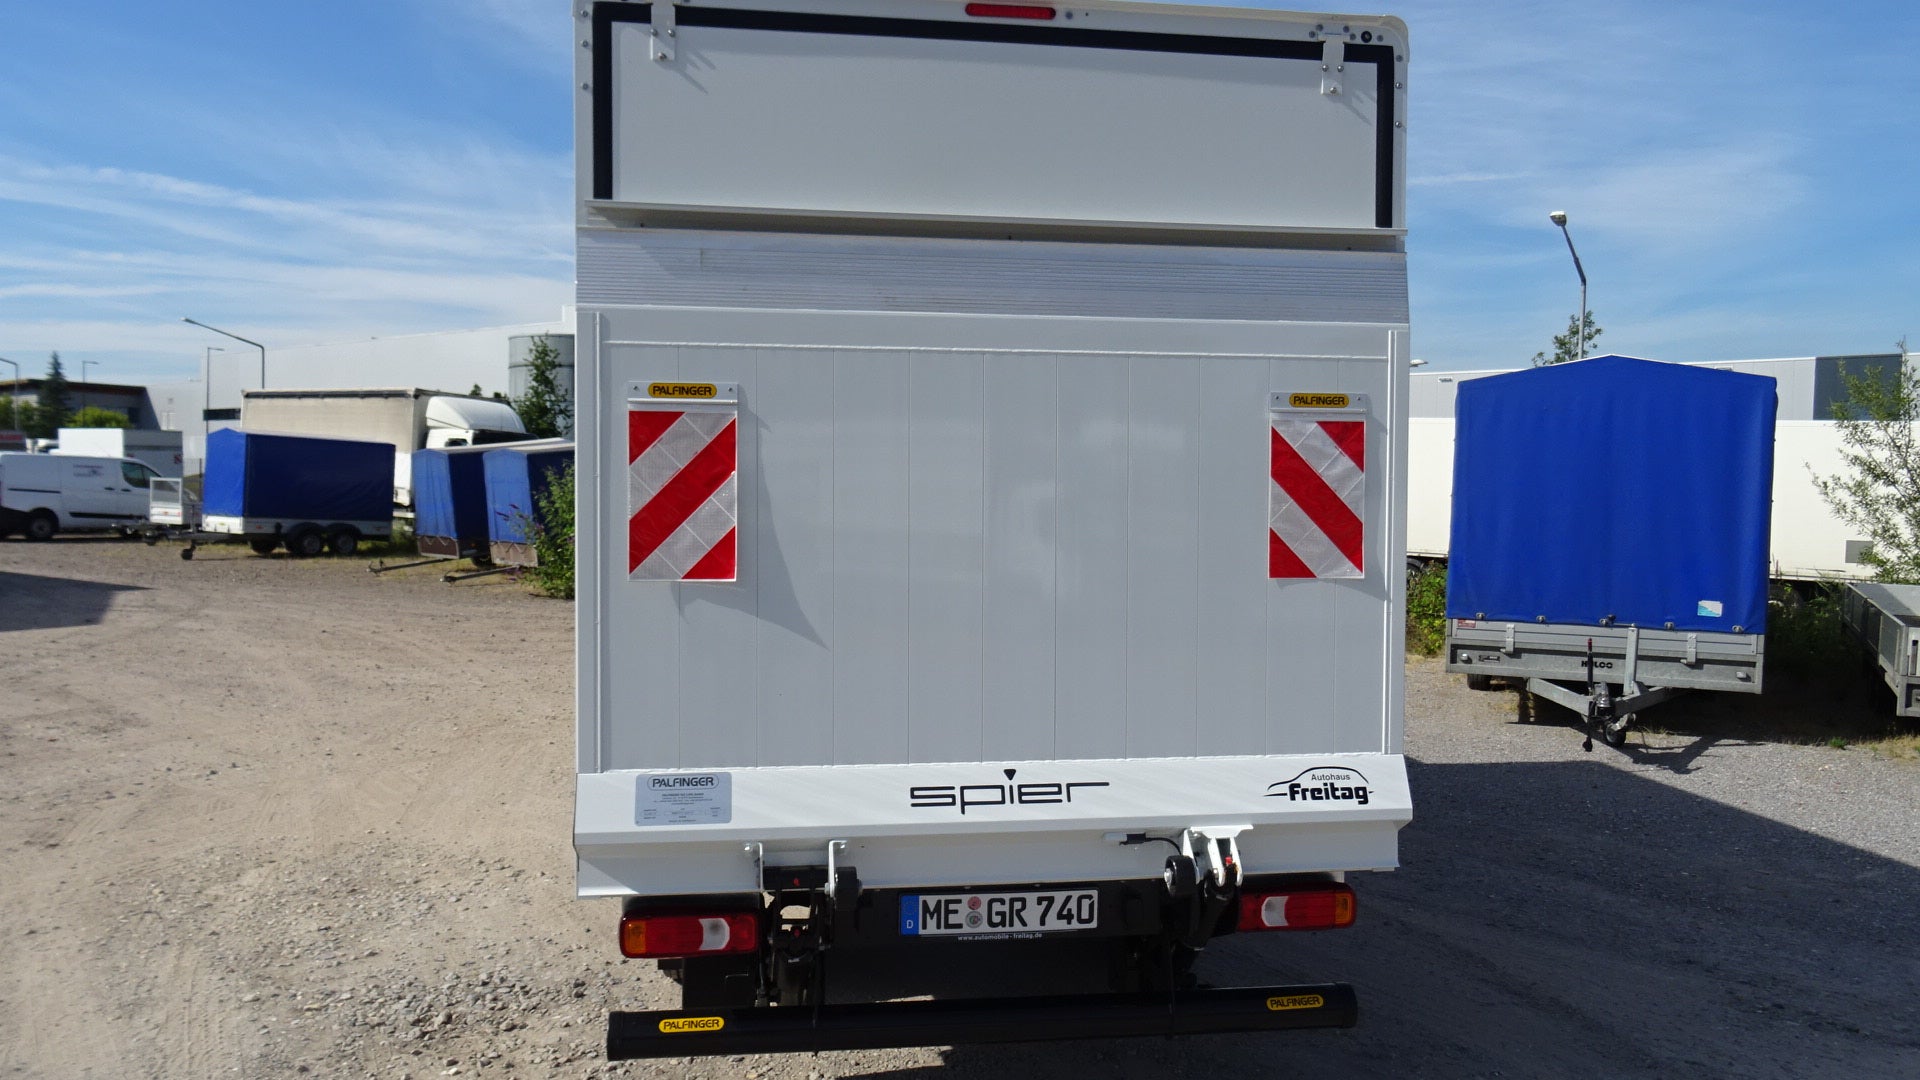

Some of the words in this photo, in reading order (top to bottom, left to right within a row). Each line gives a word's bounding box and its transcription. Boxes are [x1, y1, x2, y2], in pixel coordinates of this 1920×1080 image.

[652, 385, 712, 396] PALFINGER
[1293, 395, 1346, 405] PALFINGER
[1581, 660, 1613, 669] HLCO
[652, 776, 714, 788] PALFINGER
[1311, 773, 1351, 781] Autohaus
[910, 769, 1110, 815] spier
[1288, 782, 1369, 805] Freitag
[921, 898, 964, 931] ME
[986, 896, 1028, 928] GR
[1036, 893, 1095, 927] 740
[906, 919, 914, 929] D
[1270, 996, 1321, 1008] PALFINGER
[663, 1019, 720, 1030] PALFINGER
